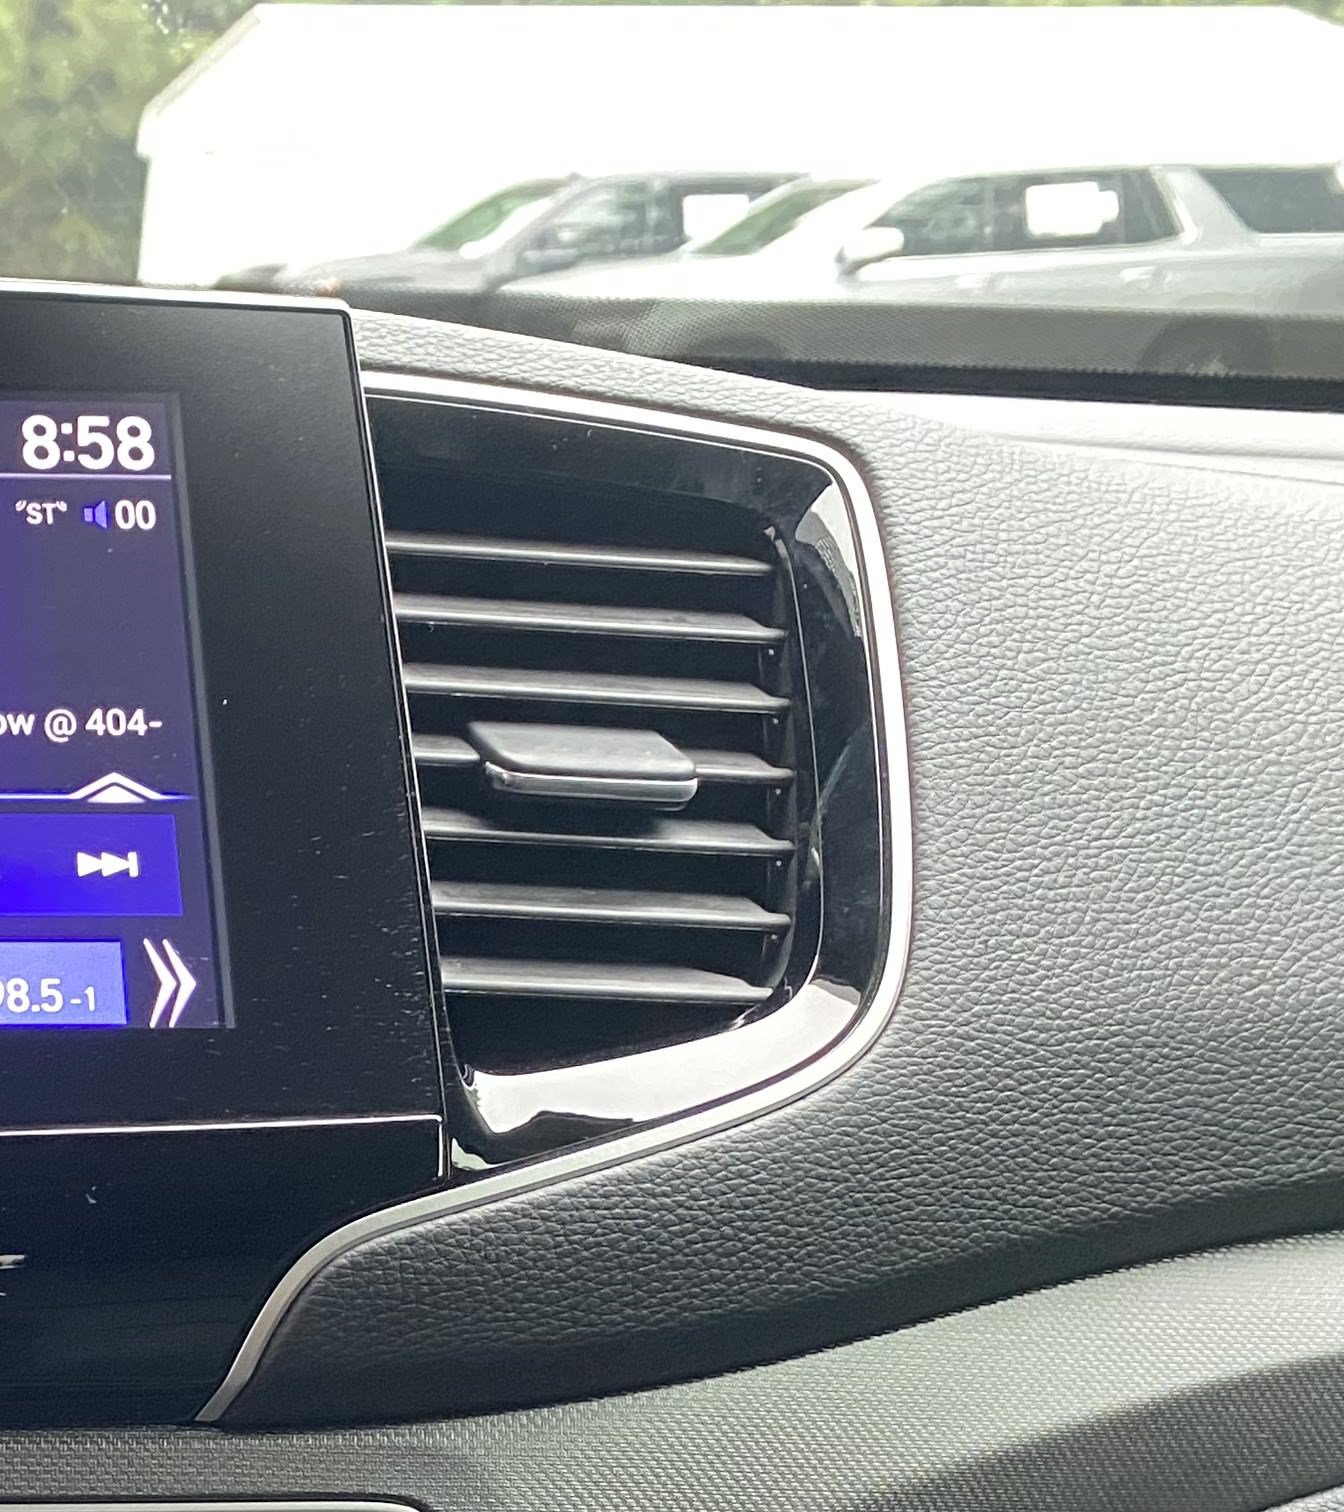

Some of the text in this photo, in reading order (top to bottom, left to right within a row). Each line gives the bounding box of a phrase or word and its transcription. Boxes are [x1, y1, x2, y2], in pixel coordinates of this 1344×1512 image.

[21, 414, 155, 471] 8:58
[115, 500, 156, 530] 00
[44, 709, 76, 743] @
[85, 708, 163, 736] 404-
